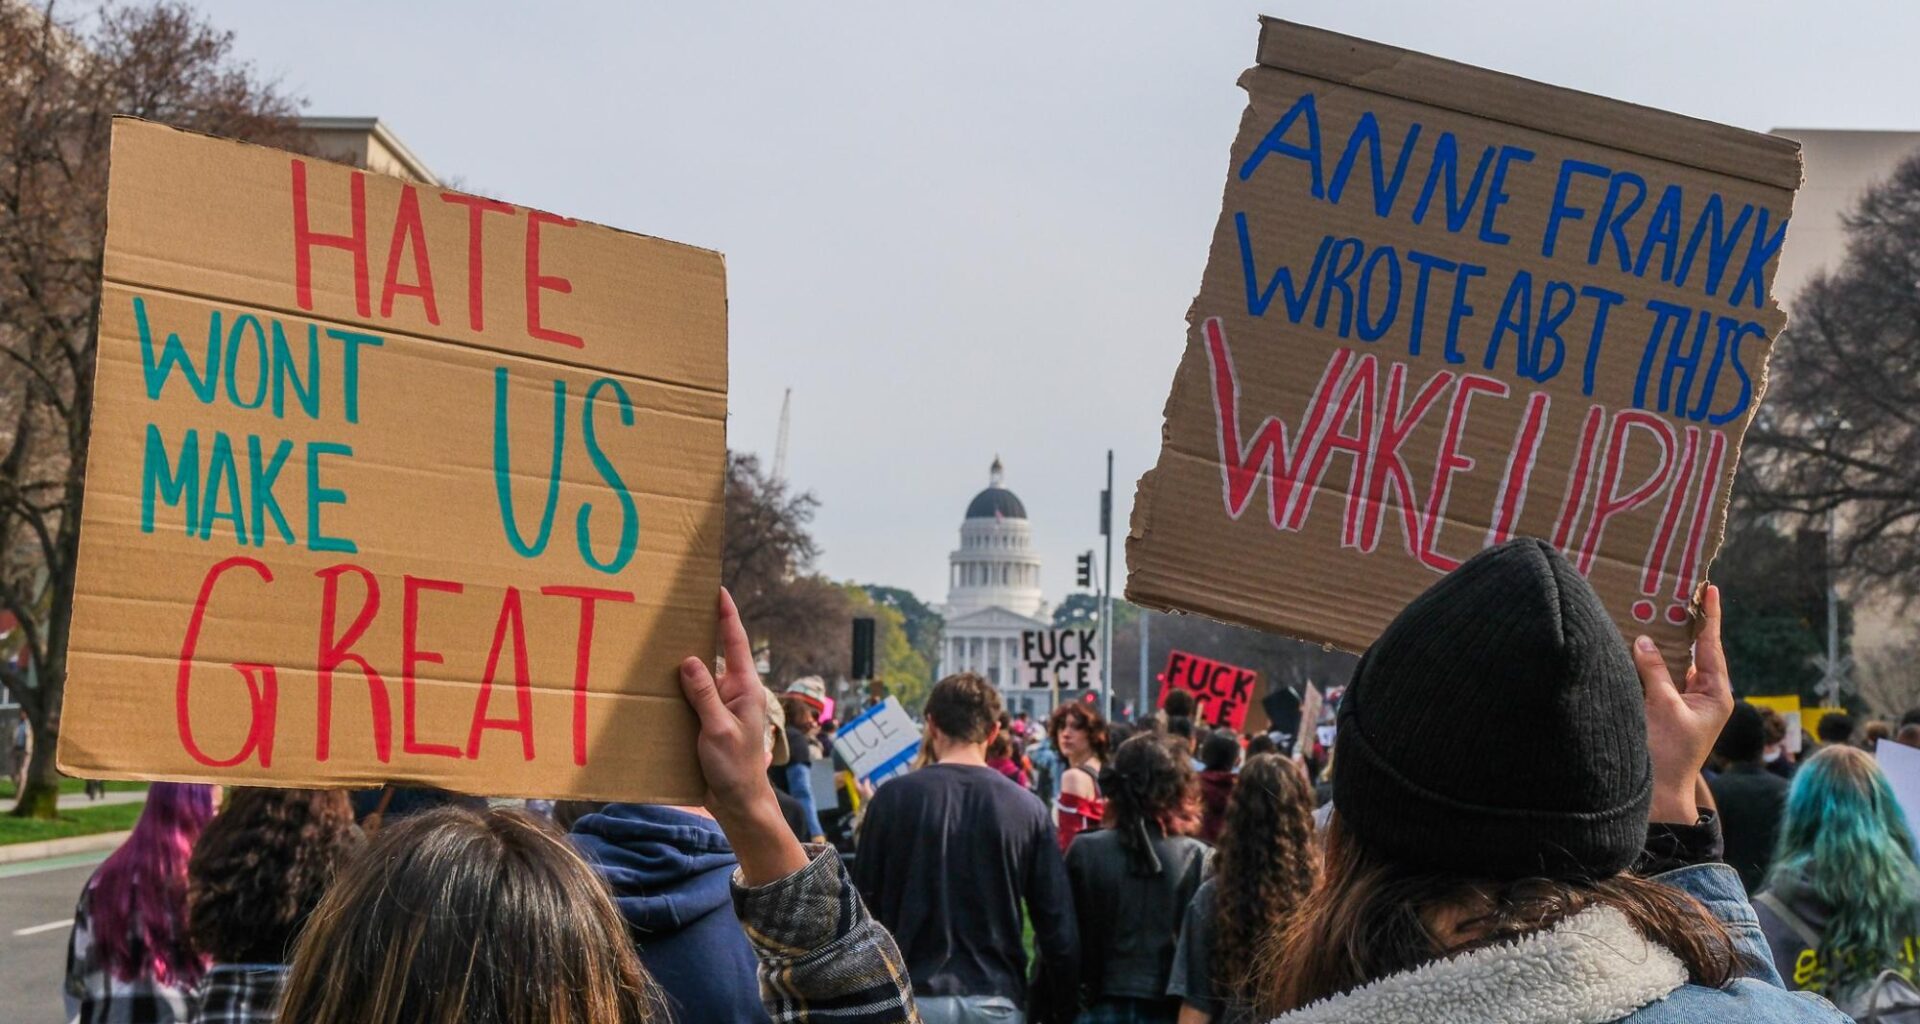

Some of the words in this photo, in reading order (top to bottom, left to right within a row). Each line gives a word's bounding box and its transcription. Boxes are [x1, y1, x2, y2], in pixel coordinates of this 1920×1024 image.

[291, 159, 585, 348] HATE
[1238, 93, 1536, 245] ANNE
[1542, 159, 1788, 309] FRANK
[133, 296, 384, 424] WONT
[1234, 211, 1487, 365] WROTE
[1484, 270, 1625, 397] ABT
[1632, 299, 1766, 426] THIS
[140, 423, 358, 554] MAKE
[494, 365, 640, 575] US
[1203, 317, 1510, 574] WAKE
[1485, 391, 1728, 625] UP!!
[176, 556, 635, 769] GREAT
[1022, 629, 1097, 661] FUCK
[1028, 661, 1091, 689] ICE
[1167, 652, 1255, 703] FUCK
